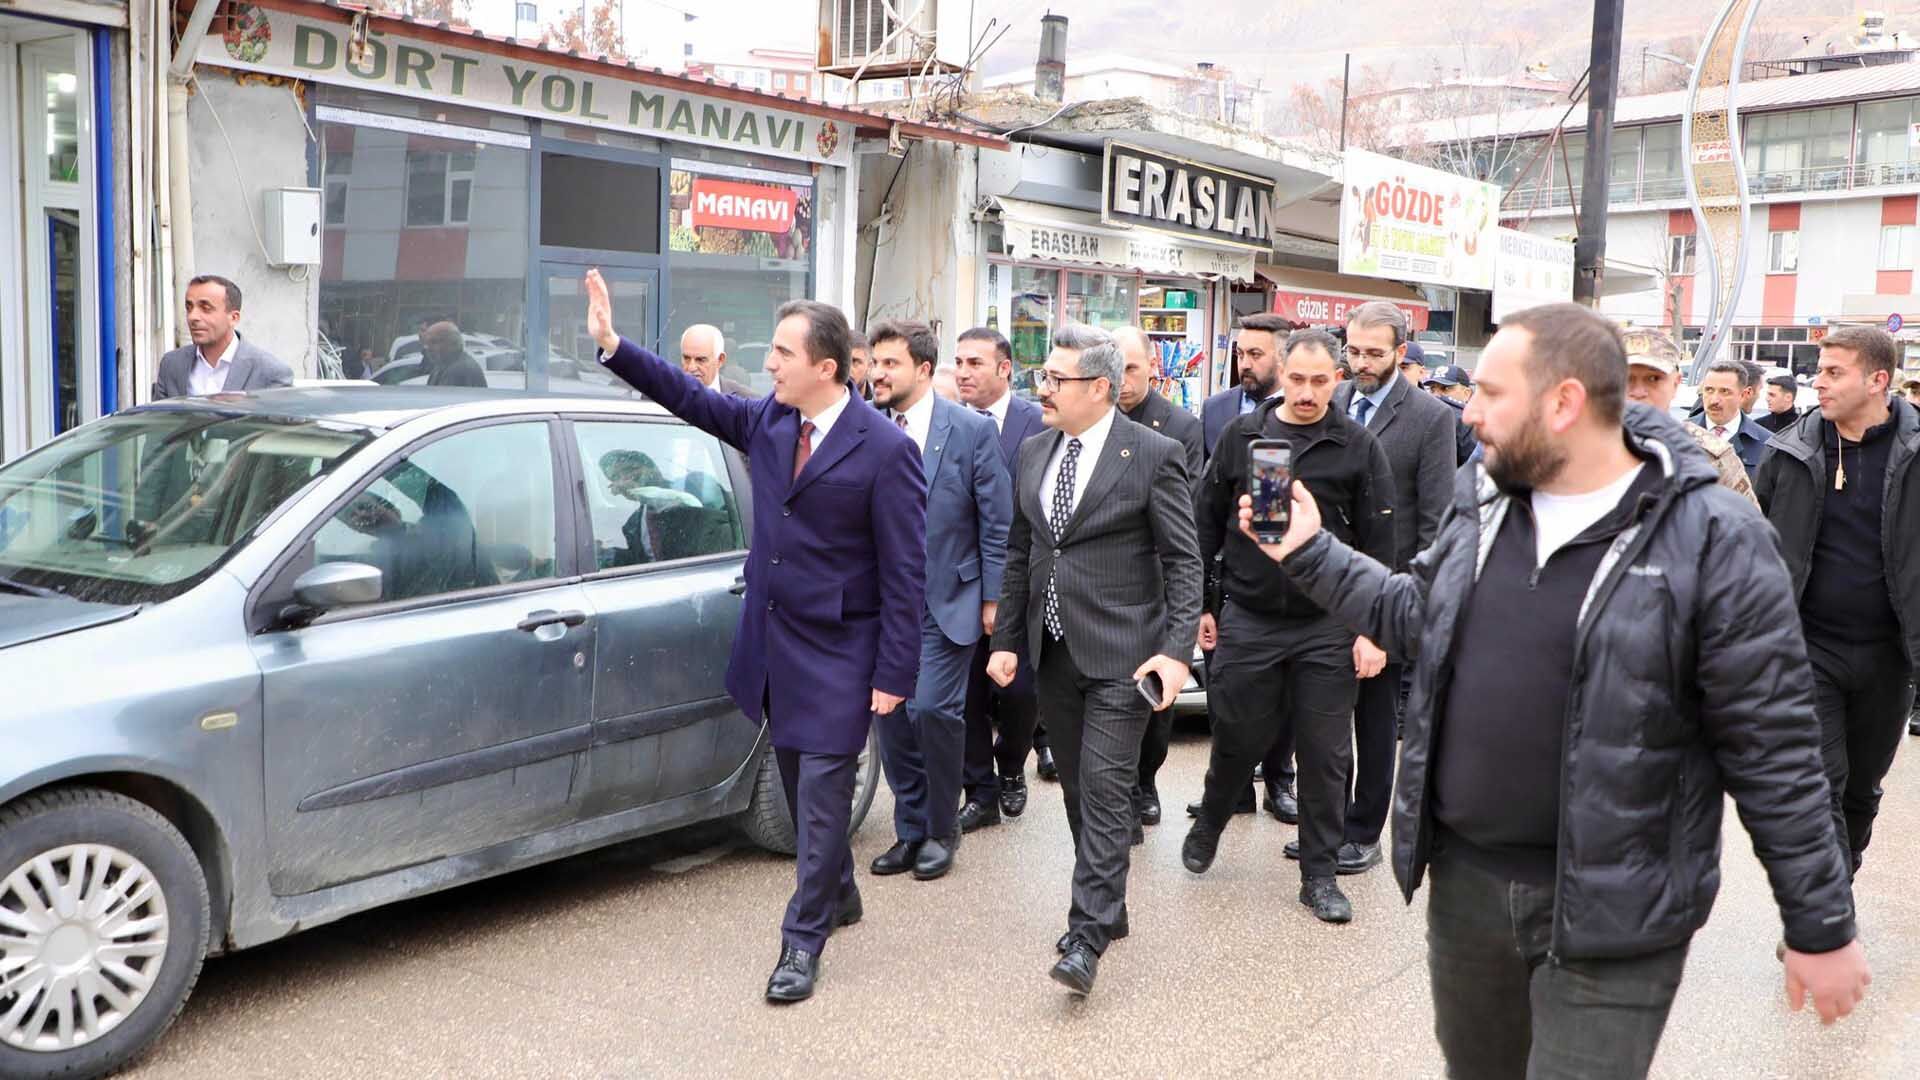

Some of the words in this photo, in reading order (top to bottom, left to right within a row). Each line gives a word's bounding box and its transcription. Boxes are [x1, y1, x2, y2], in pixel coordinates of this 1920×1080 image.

[293, 24, 479, 96] DÖRT
[503, 65, 608, 120] YOL
[628, 90, 804, 151] MANAVI
[697, 192, 788, 221] MANAVI
[1114, 155, 1274, 241] ERASLAN
[1375, 176, 1445, 226] GÖZDE
[1031, 229, 1099, 257] ERASLAN
[1297, 296, 1329, 320] GÖZDE
[1335, 303, 1346, 321] ET
